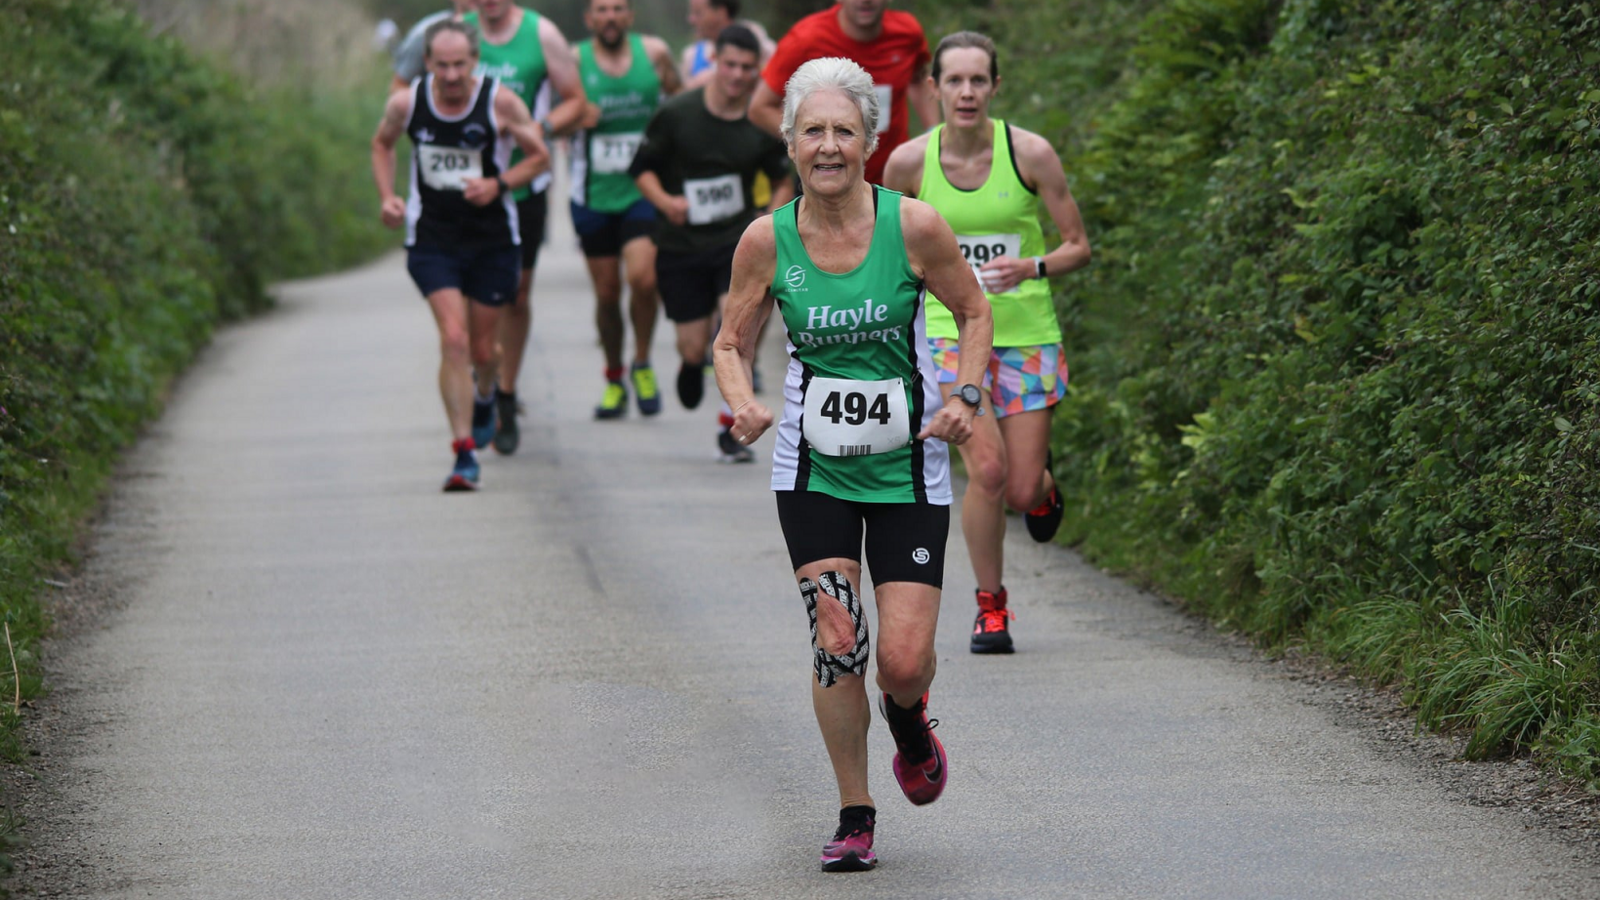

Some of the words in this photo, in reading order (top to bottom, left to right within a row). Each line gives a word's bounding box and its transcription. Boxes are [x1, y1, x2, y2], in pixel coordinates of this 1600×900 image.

[430, 153, 470, 172] 203
[696, 183, 734, 205] 590
[805, 298, 888, 331] Hayle
[797, 325, 903, 348] Runners
[820, 391, 891, 426] 494
